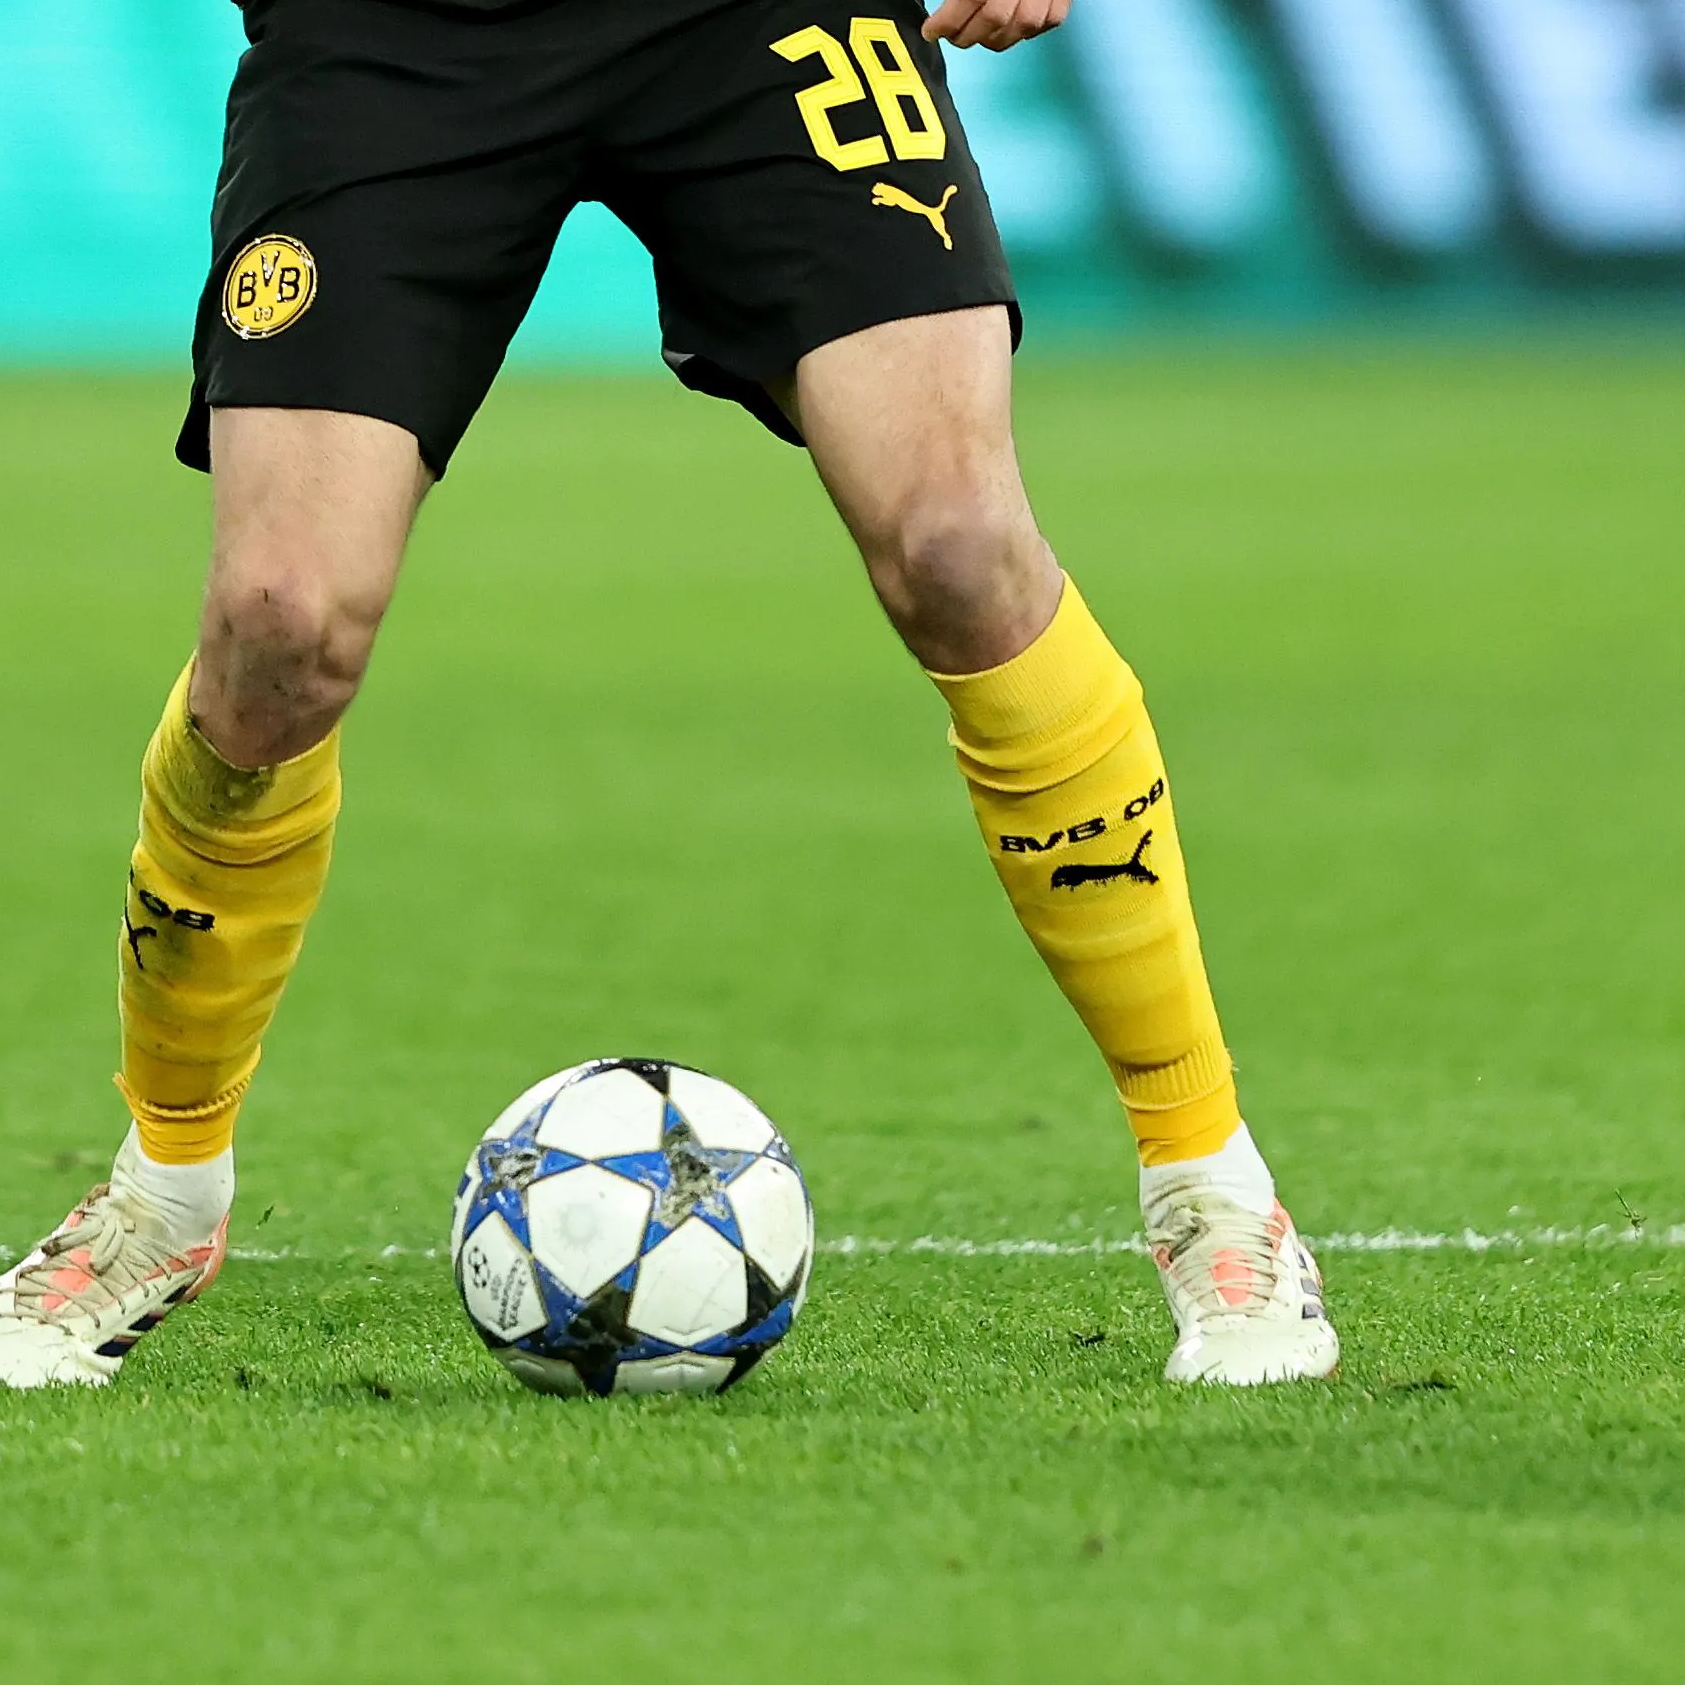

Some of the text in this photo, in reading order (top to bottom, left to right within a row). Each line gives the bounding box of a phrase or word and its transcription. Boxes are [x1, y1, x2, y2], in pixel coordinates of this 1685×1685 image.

[768, 16, 947, 173] 28
[236, 250, 301, 309] BVB
[999, 816, 1107, 854] BVB
